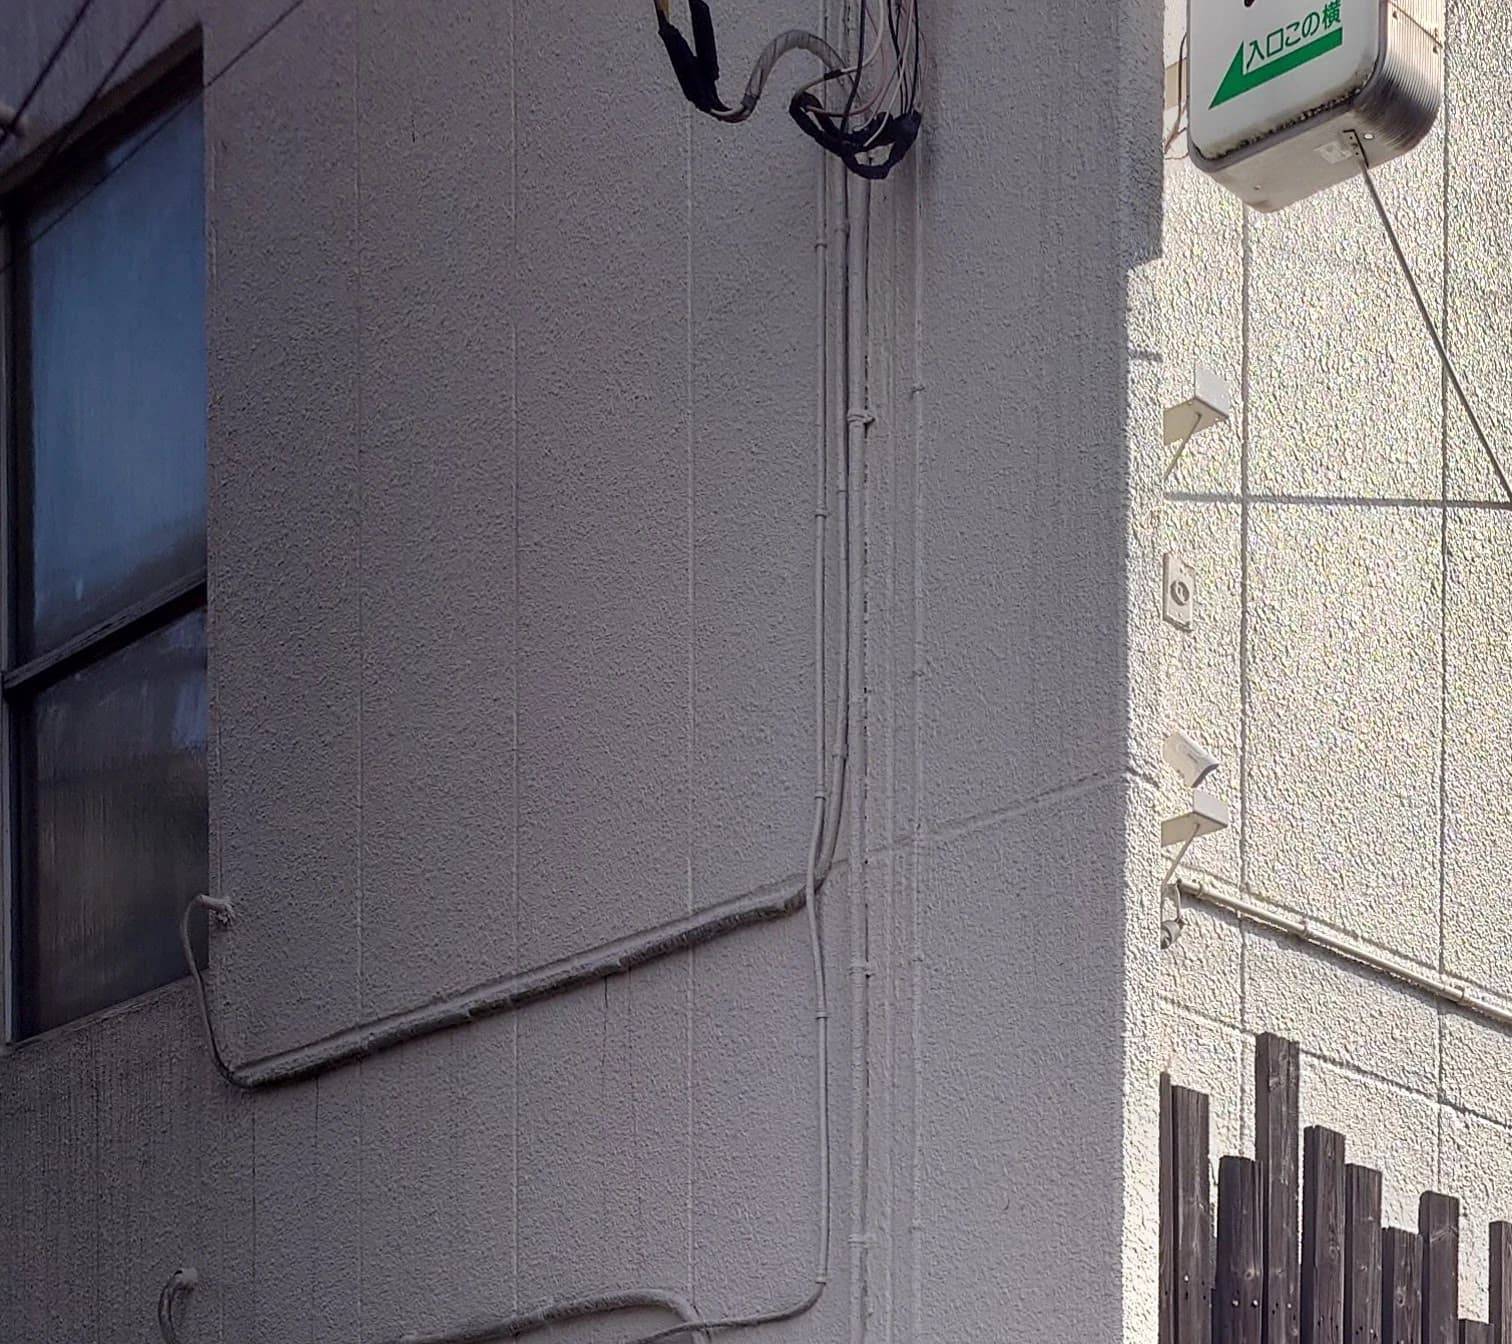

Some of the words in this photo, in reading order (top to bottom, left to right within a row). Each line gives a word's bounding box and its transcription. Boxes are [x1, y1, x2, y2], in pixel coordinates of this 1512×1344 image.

[1246, 0, 1342, 70] 入口この横
